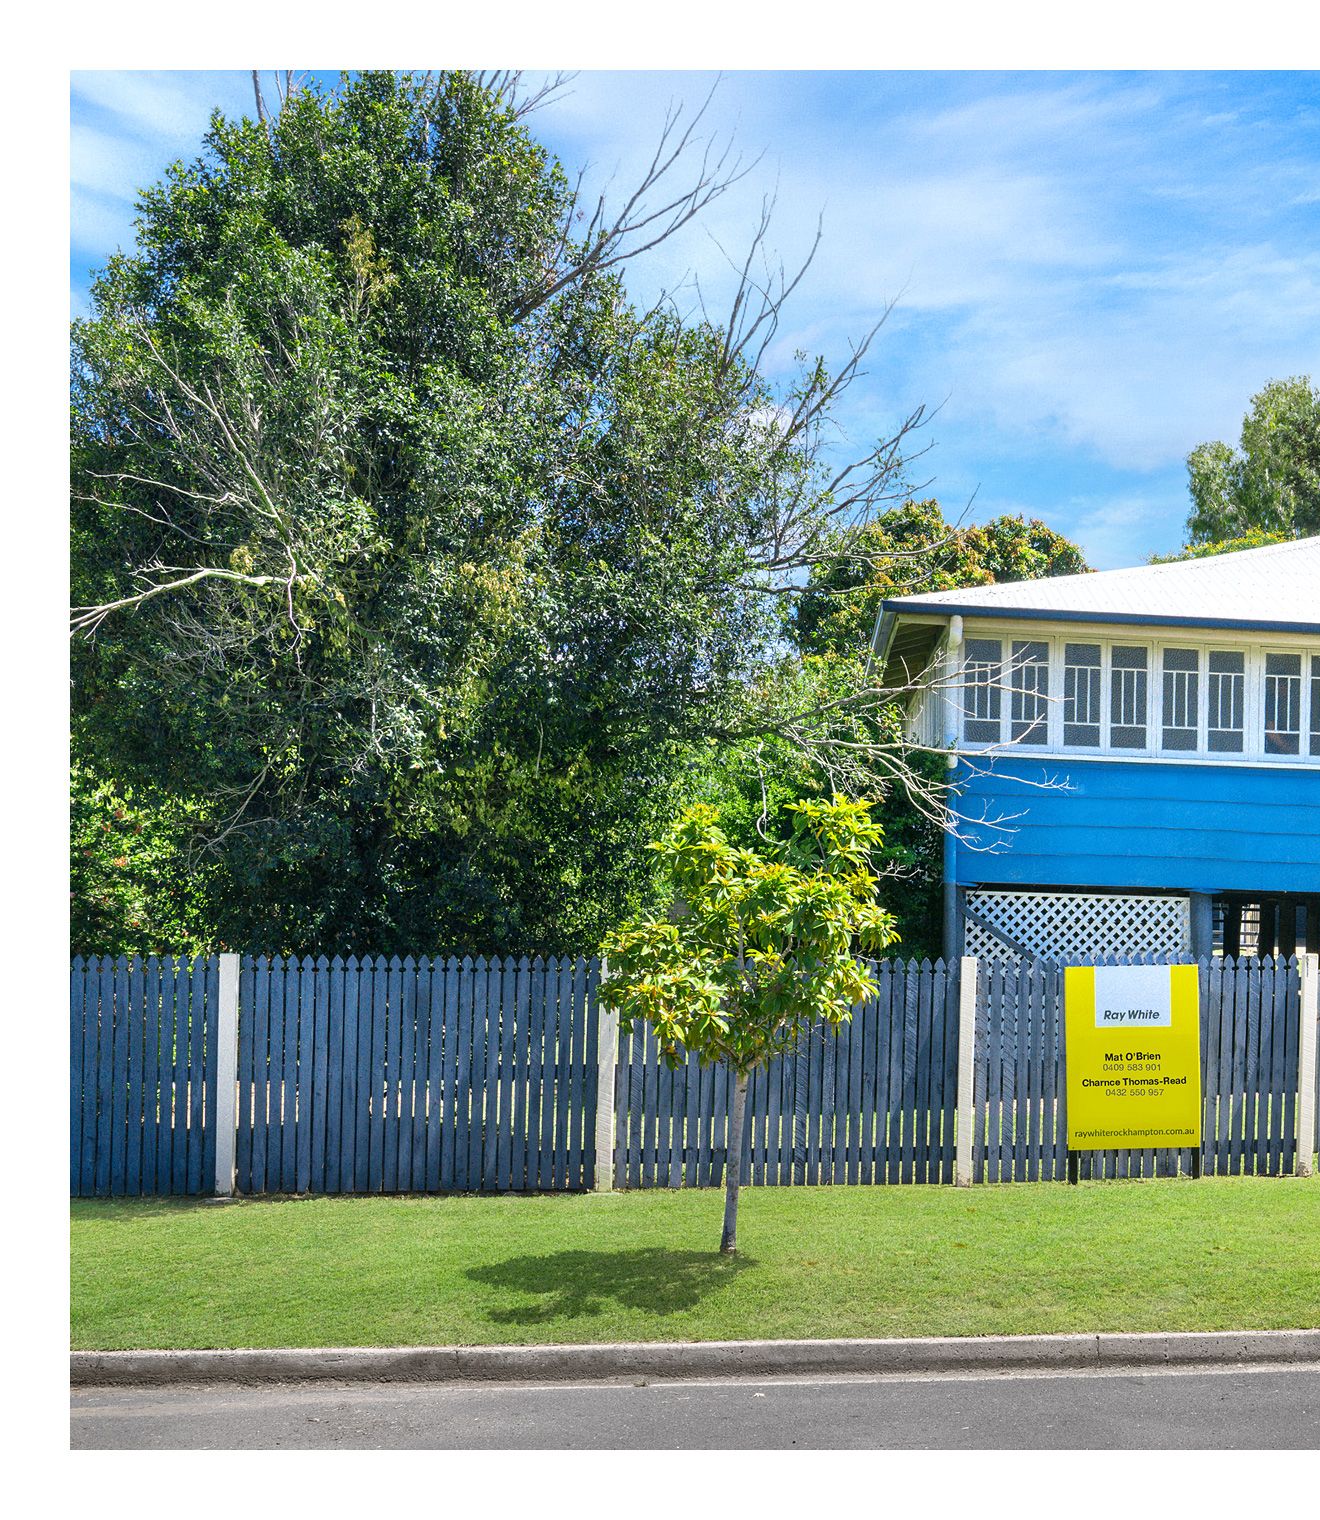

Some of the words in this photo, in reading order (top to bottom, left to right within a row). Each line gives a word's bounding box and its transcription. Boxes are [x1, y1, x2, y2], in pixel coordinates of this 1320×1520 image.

[1103, 1009, 1126, 1022] Ray
[1127, 1009, 1160, 1020] White
[1104, 1053, 1124, 1062] Mat
[1125, 1051, 1161, 1061] O'Brien
[1102, 1063, 1125, 1072] 0409
[1126, 1063, 1144, 1072] 583
[1145, 1063, 1162, 1072] 901
[1081, 1078, 1121, 1088] Charnce
[1122, 1076, 1187, 1087] Thomas-Read
[1105, 1088, 1127, 1097] 0432
[1129, 1088, 1146, 1097] 550
[1147, 1088, 1165, 1097] 957
[1074, 1127, 1195, 1139] raywhiterockhampton.com.au
